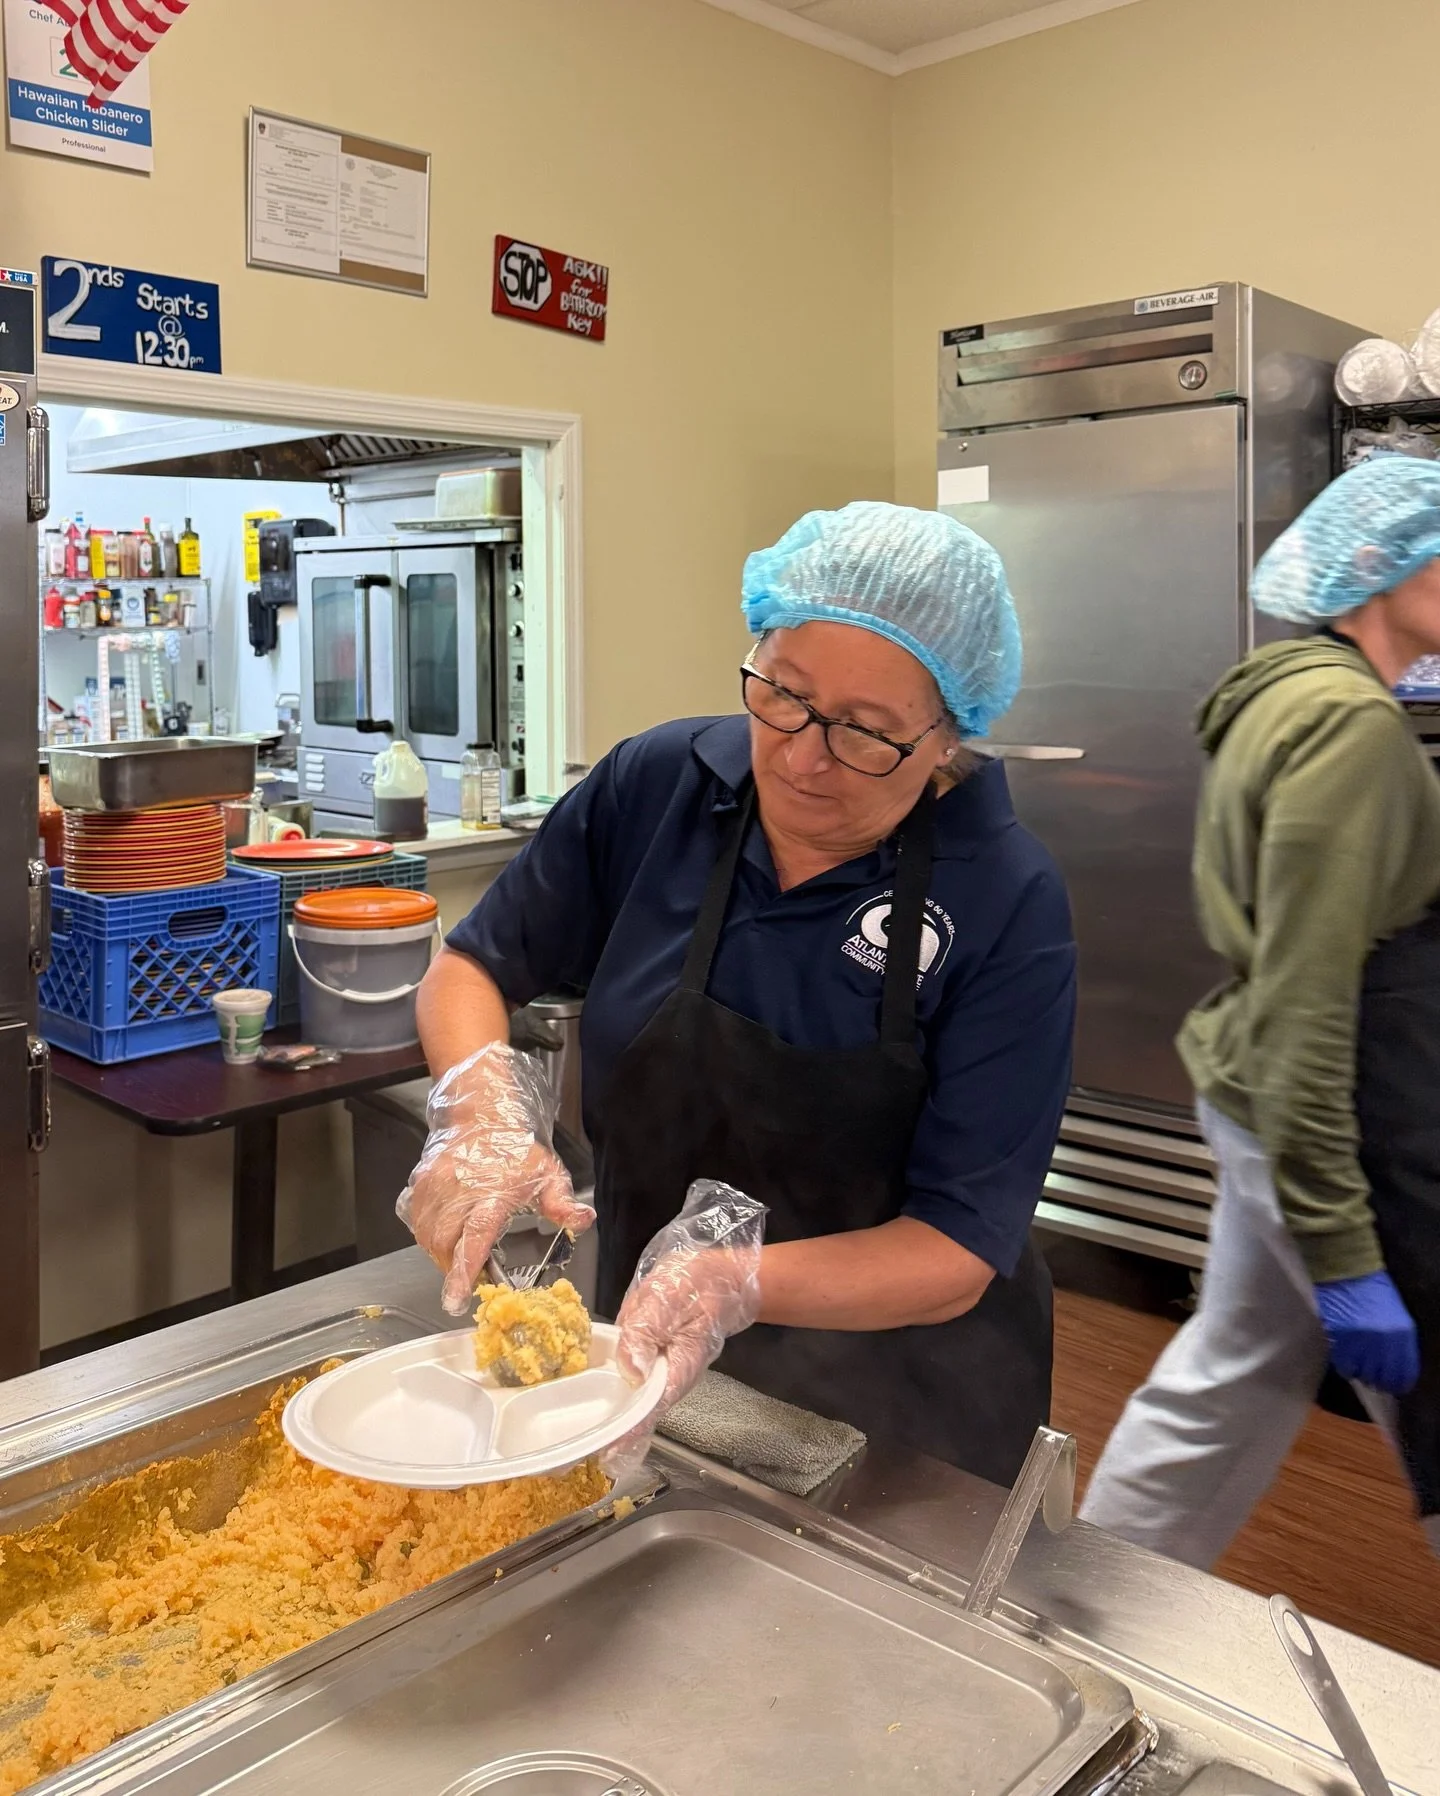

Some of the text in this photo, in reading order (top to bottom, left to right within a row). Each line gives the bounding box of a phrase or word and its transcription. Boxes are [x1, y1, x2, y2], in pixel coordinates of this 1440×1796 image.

[29, 9, 53, 24] Chef
[18, 85, 78, 110] Hawaiian
[35, 106, 129, 137] Chicken Slider
[61, 137, 106, 153] Professional
[503, 250, 548, 304] STOP
[136, 283, 209, 319] Starts
[158, 315, 186, 338] @
[840, 944, 886, 976] COMMUNITY
